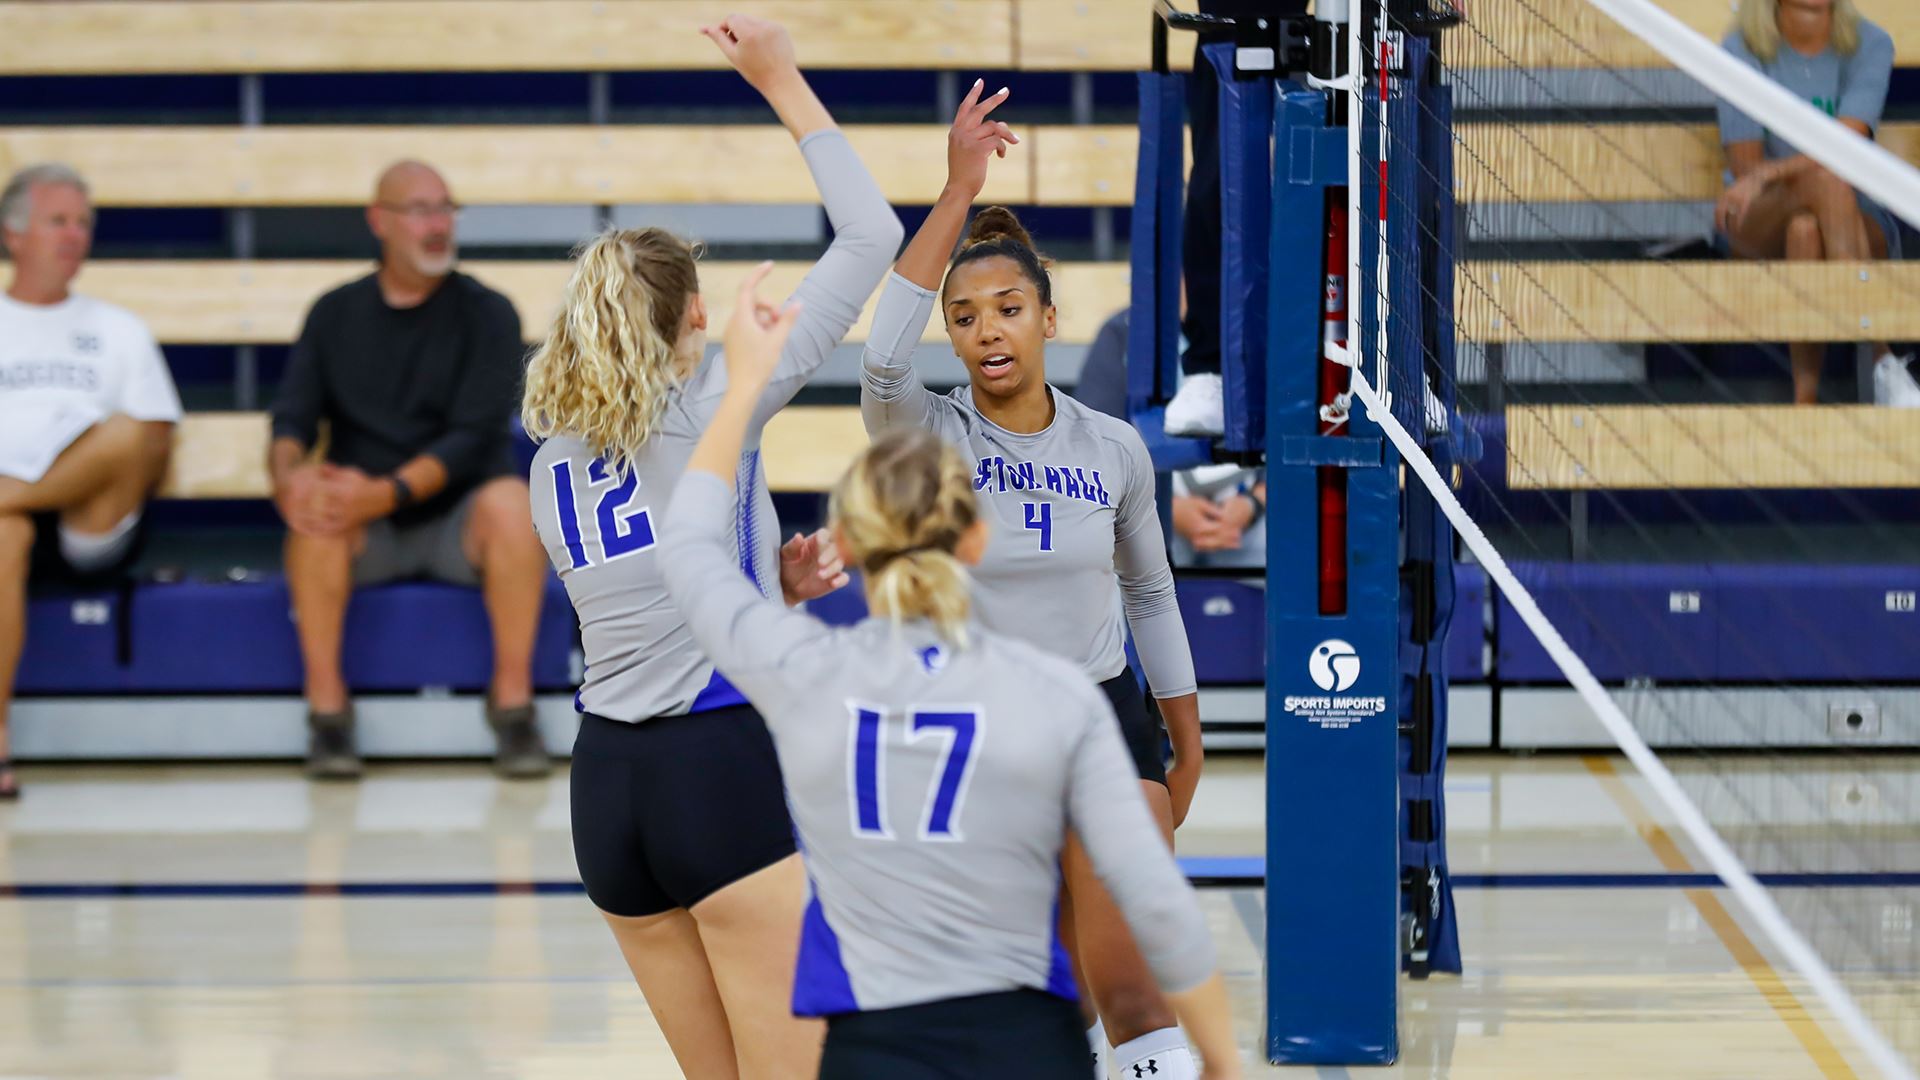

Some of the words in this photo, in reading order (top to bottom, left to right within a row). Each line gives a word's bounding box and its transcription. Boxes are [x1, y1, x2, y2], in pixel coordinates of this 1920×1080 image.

[1043, 465, 1111, 509] HALL
[547, 455, 657, 571] 12
[1022, 501, 1054, 553] 4
[1894, 592, 1910, 611] 10
[1284, 696, 1331, 712] SPORTS
[1332, 696, 1386, 712] IMPORTS
[845, 697, 985, 842] 17
